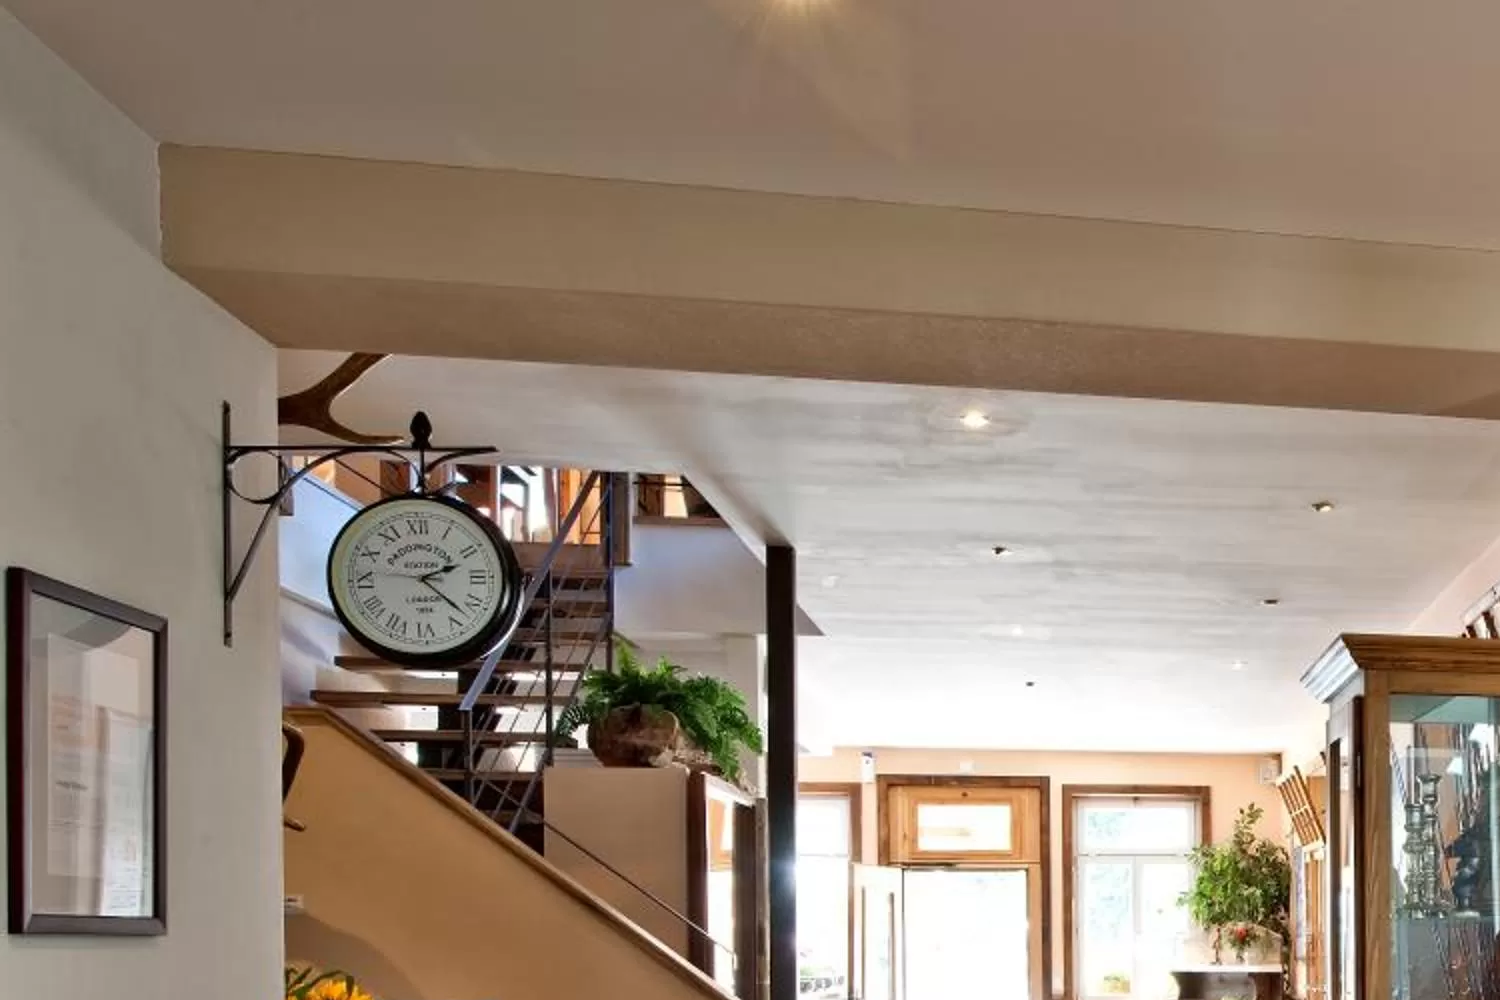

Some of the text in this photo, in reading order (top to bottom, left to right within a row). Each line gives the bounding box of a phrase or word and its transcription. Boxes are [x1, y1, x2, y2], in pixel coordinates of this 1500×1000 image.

[378, 525, 401, 546] XI
[406, 519, 429, 535] XII
[361, 545, 380, 563] X
[387, 542, 453, 567] PADDINGTON
[460, 545, 477, 559] II
[469, 569, 486, 585] III
